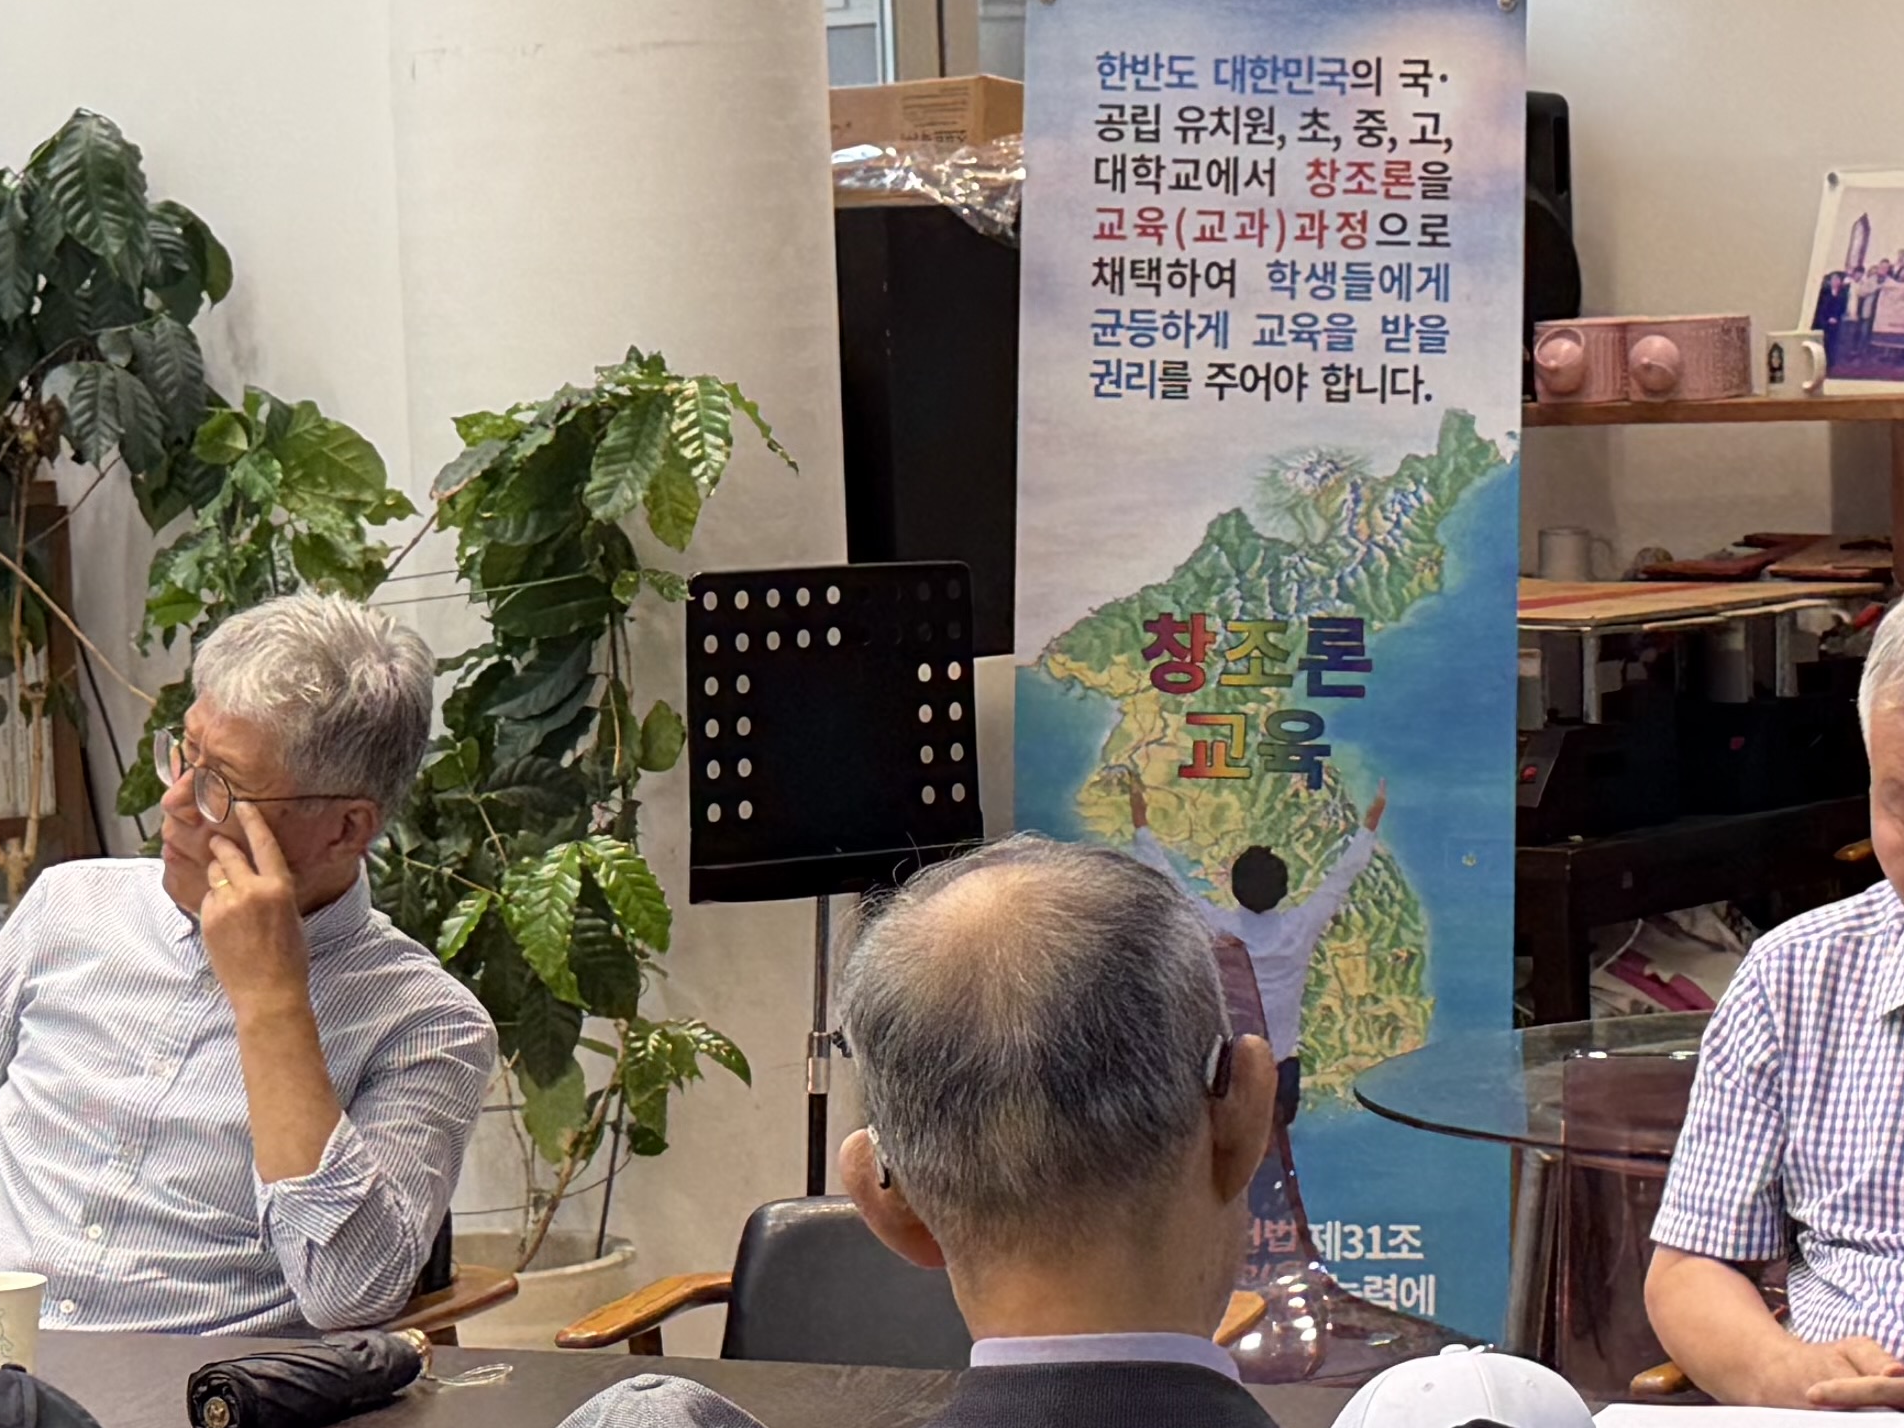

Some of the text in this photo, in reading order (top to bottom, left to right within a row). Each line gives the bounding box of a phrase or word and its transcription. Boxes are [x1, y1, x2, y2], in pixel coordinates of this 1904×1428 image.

[1096, 51, 1197, 93] 한반도
[1213, 54, 1383, 97] 대한민국의
[1094, 103, 1454, 154] 공립 유치원, 초, 중, 고,
[1093, 153, 1453, 201] 대학교에서 창조론을
[1092, 206, 1452, 252] 교육(교과)과정으로
[1091, 257, 1451, 303] 채택하여 학생들에게
[1090, 308, 1450, 355] 균등하게 교육을 받을
[1089, 359, 1433, 404] 권리를 주어야 합니다.
[1141, 611, 1373, 699] 창조론
[1177, 708, 1331, 791] 교육
[1308, 1220, 1425, 1262] 제31조
